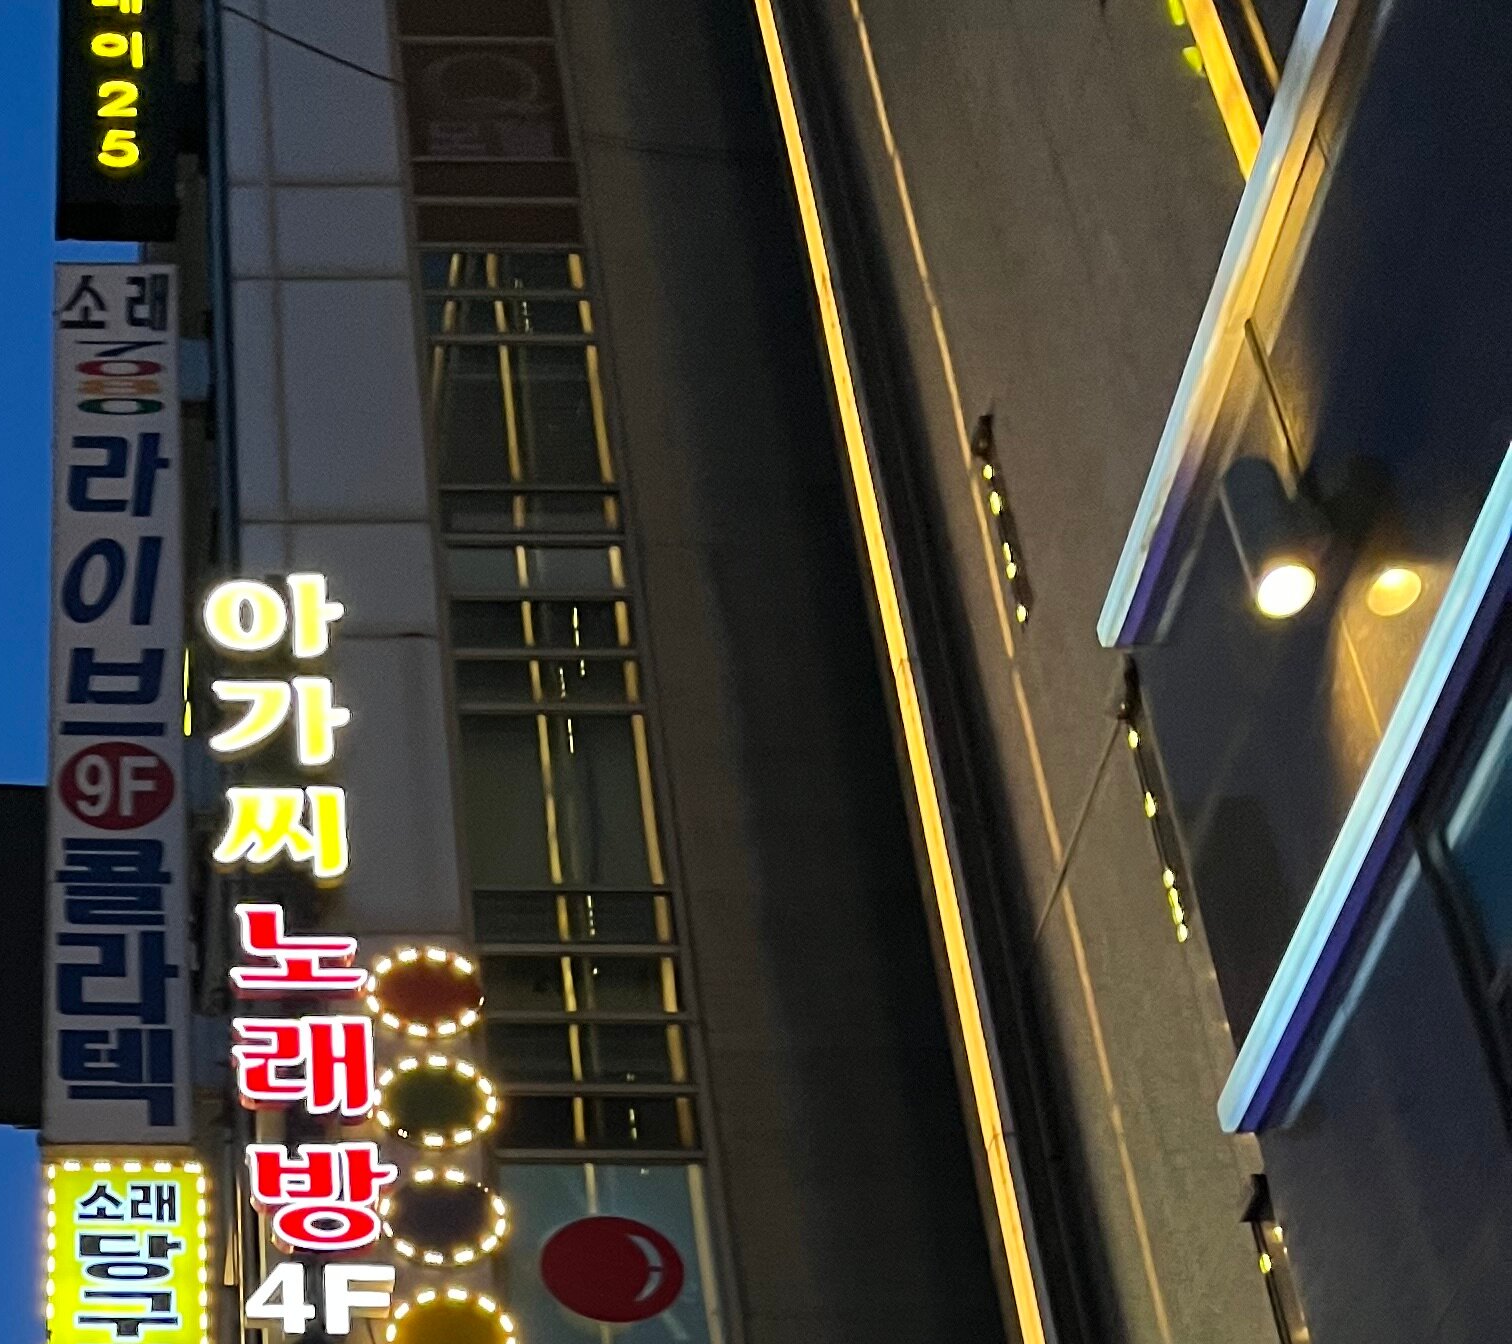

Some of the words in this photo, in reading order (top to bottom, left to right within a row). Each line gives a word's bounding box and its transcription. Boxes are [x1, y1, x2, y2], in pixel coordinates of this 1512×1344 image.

[91, 0, 144, 168] 이25
[60, 273, 170, 332] 소래
[74, 754, 162, 818] 9F
[203, 573, 350, 878] 아가씨
[55, 837, 179, 1127] 콜라텍
[230, 902, 398, 1251] 노래방
[76, 1182, 178, 1225] 소래
[245, 1262, 396, 1336] 4F
